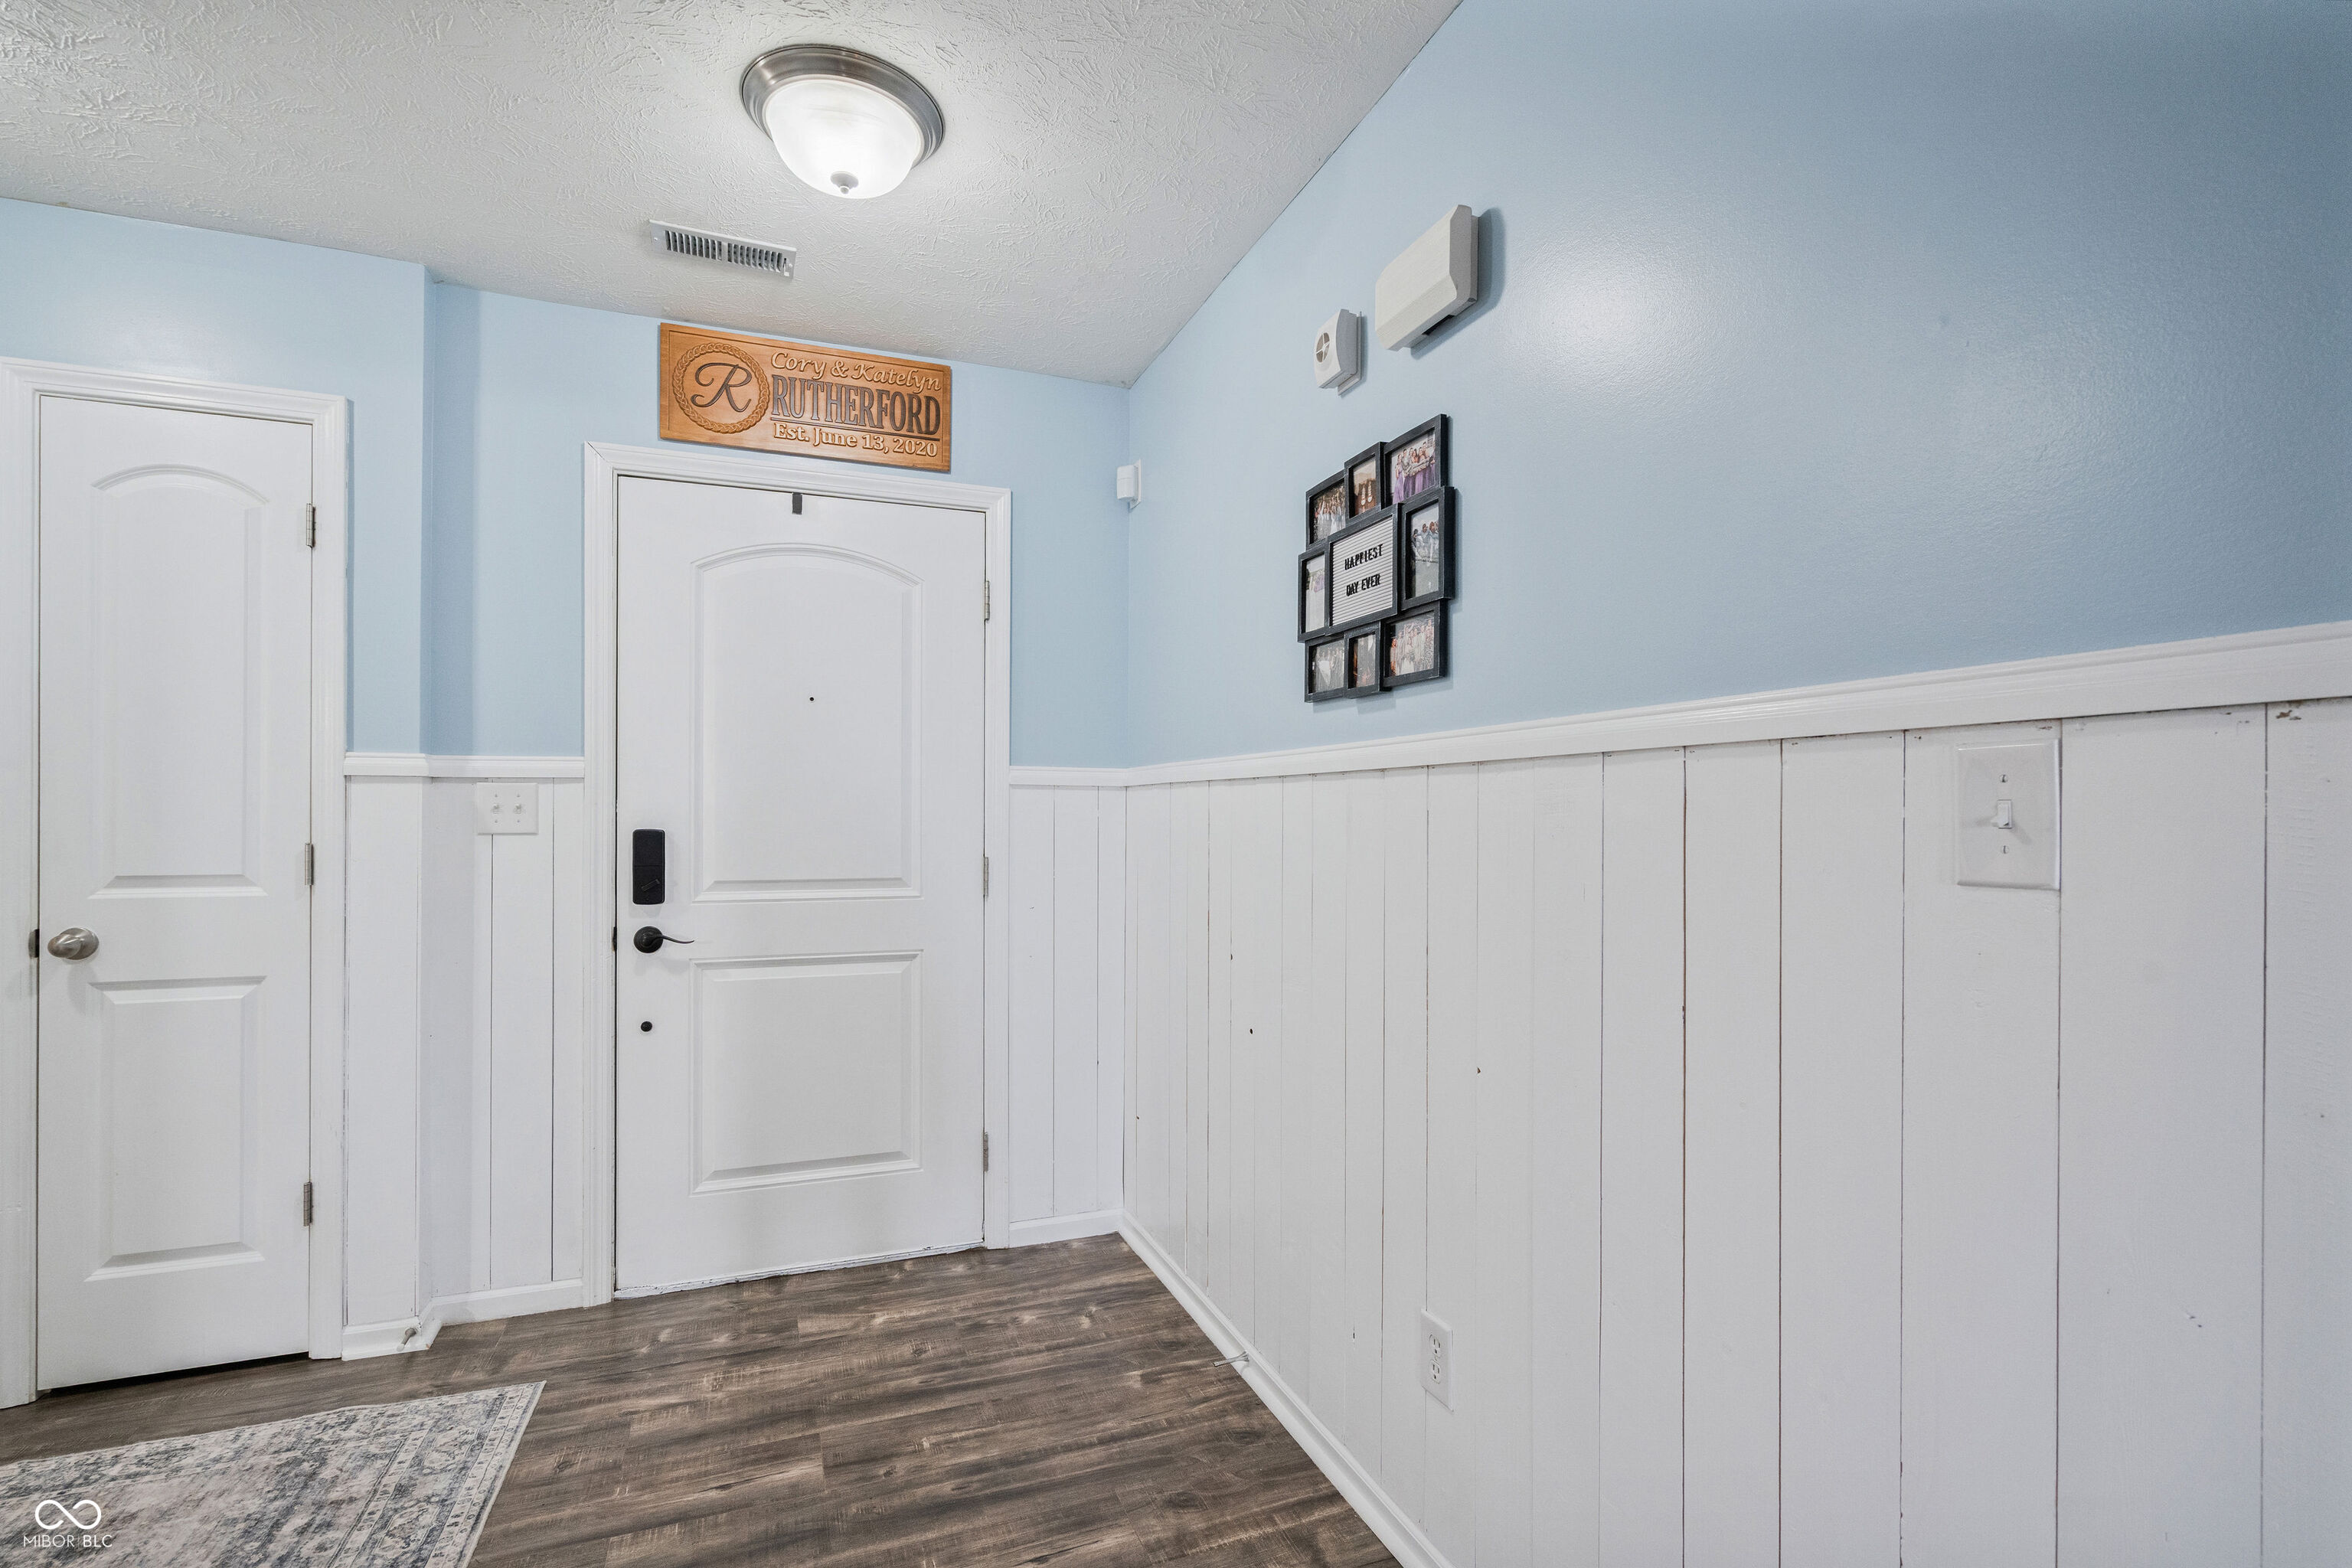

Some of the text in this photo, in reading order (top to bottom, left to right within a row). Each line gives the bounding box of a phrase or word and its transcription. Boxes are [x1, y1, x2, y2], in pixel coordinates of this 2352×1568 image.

[691, 362, 753, 413] R
[770, 351, 942, 394] Cory & Katelyn
[771, 374, 941, 436] RUTHERFORD
[773, 422, 938, 458] Est. June 13, 2020
[1344, 544, 1383, 570] HAPPIEST
[1346, 573, 1381, 596] DAY EVER
